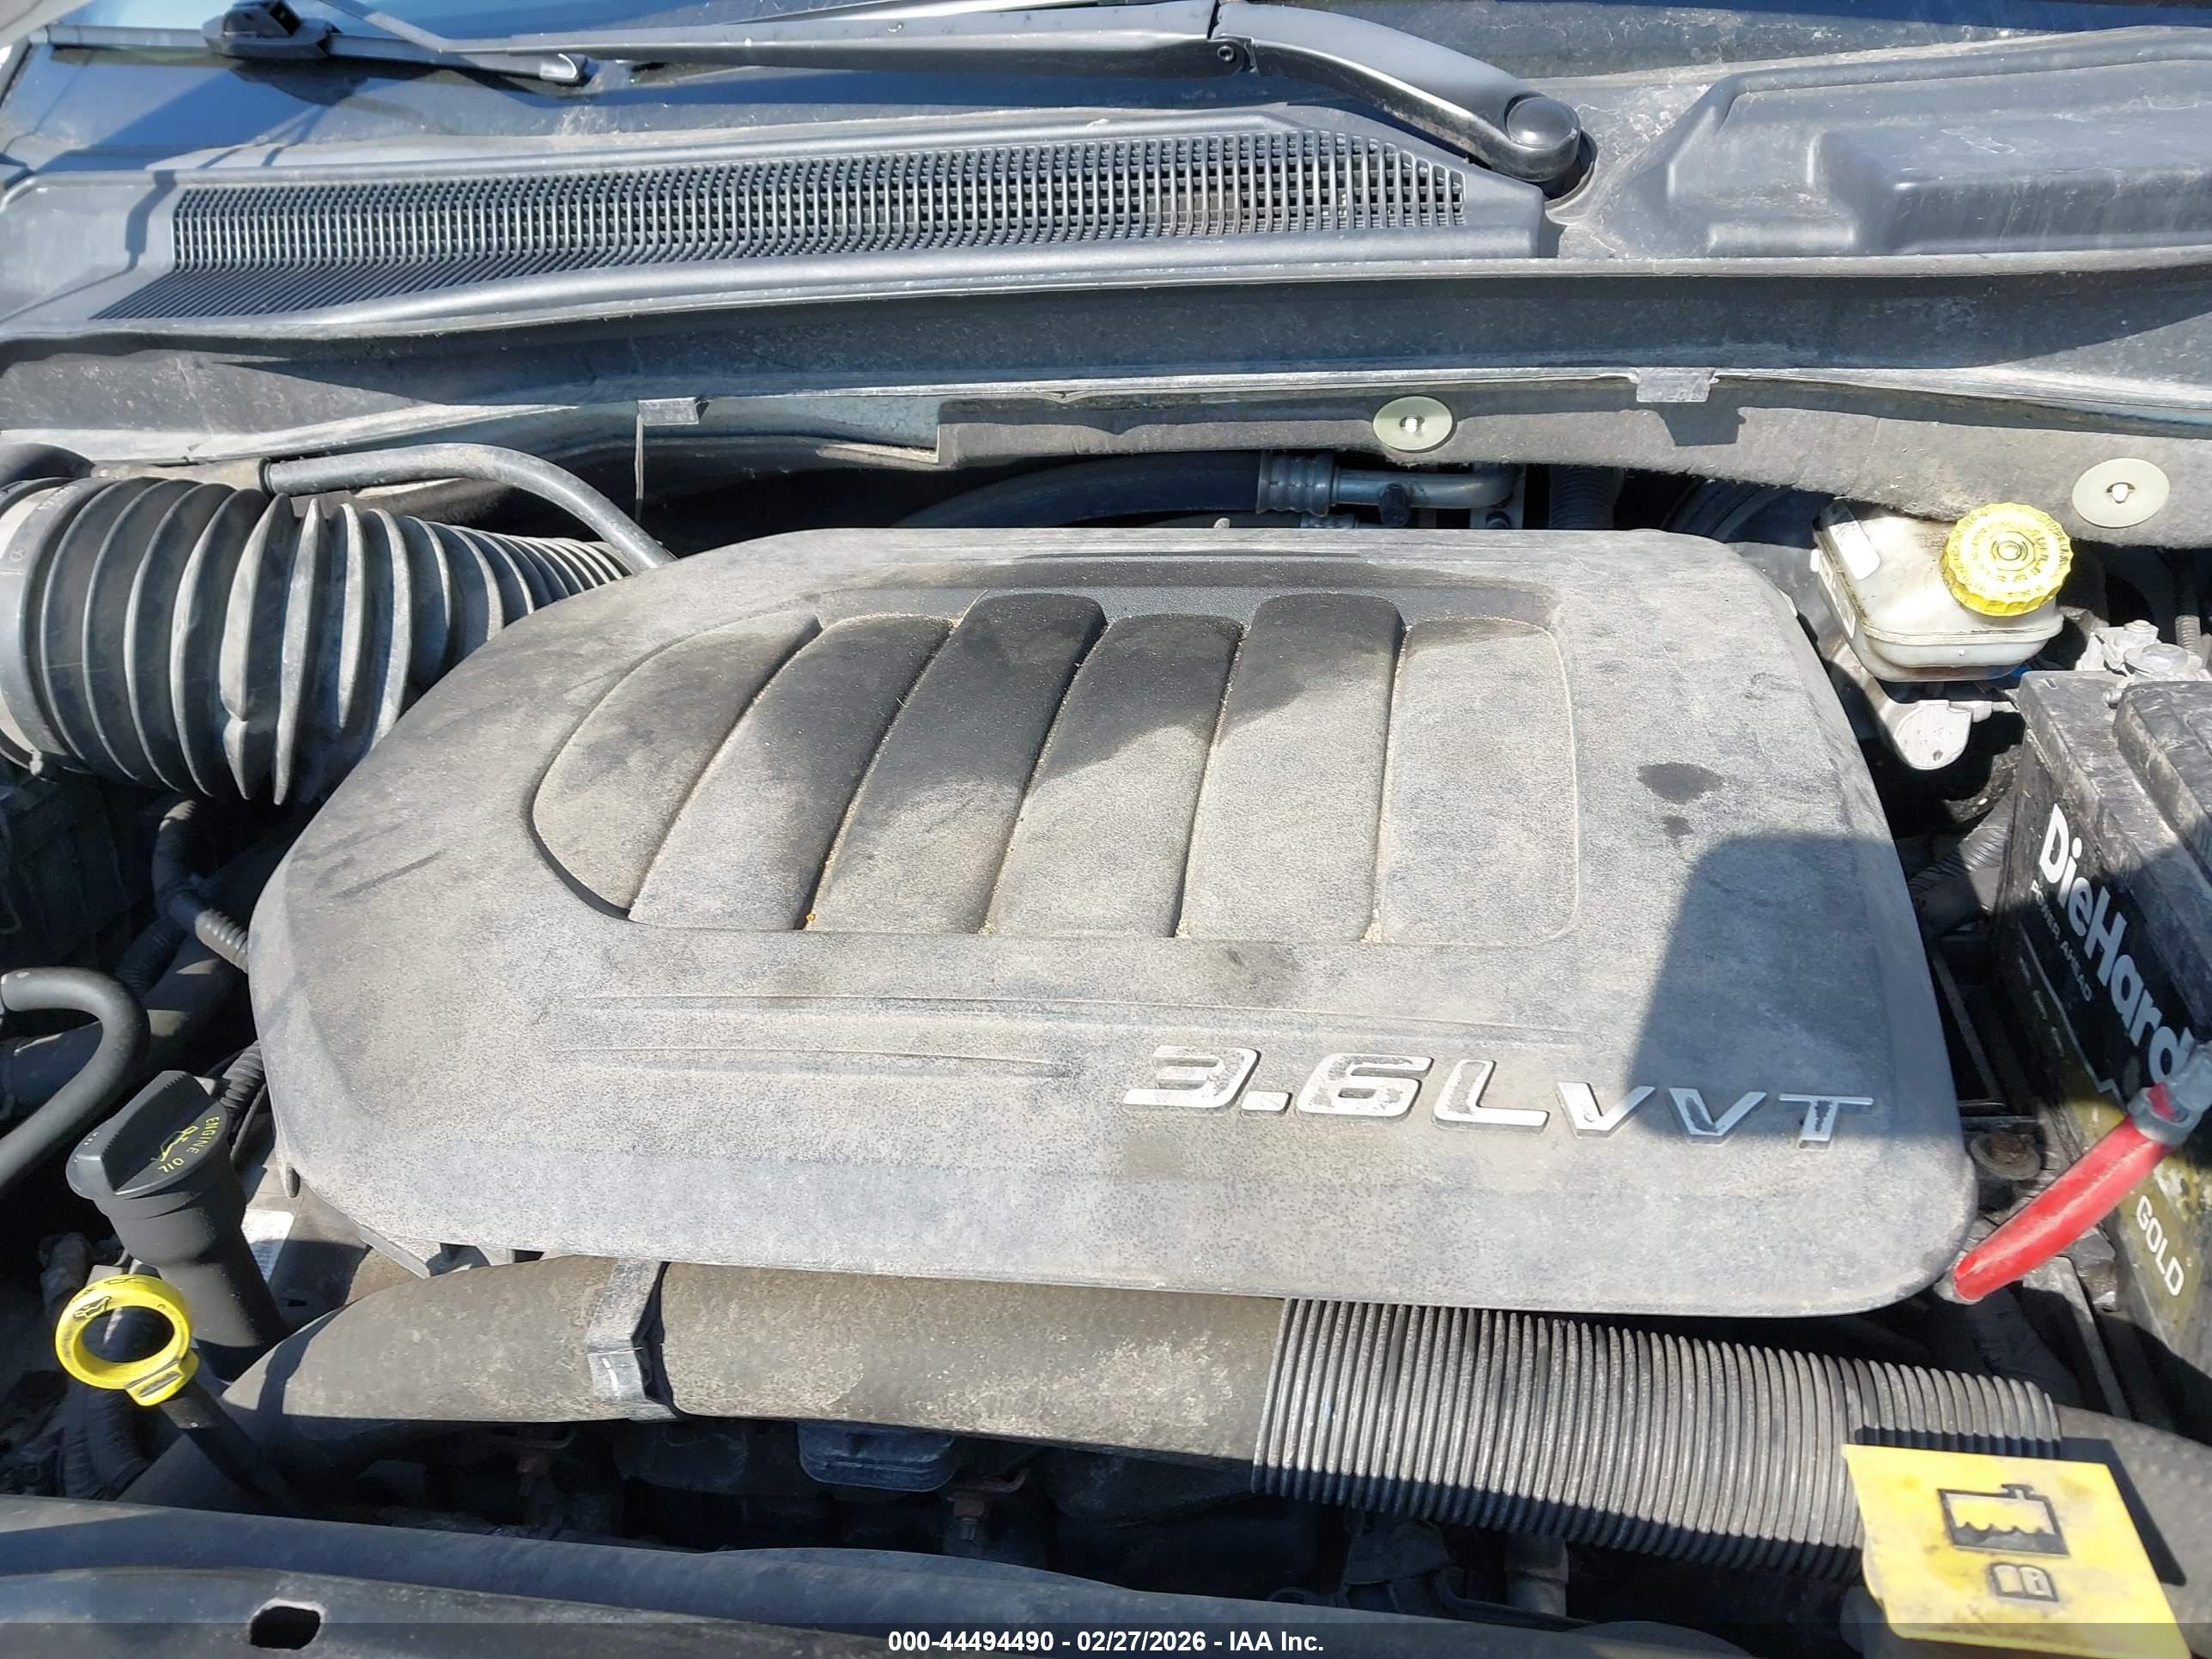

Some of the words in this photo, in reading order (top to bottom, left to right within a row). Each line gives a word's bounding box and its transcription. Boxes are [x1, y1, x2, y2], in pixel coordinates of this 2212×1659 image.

[2039, 803, 2195, 1086] DieHard
[185, 1117, 220, 1154] ENGINE
[1122, 1045, 1549, 1132] 3.6L
[1557, 1081, 1875, 1150] VVT
[157, 1158, 185, 1173] OIL
[2136, 1194, 2185, 1296] GOLD
